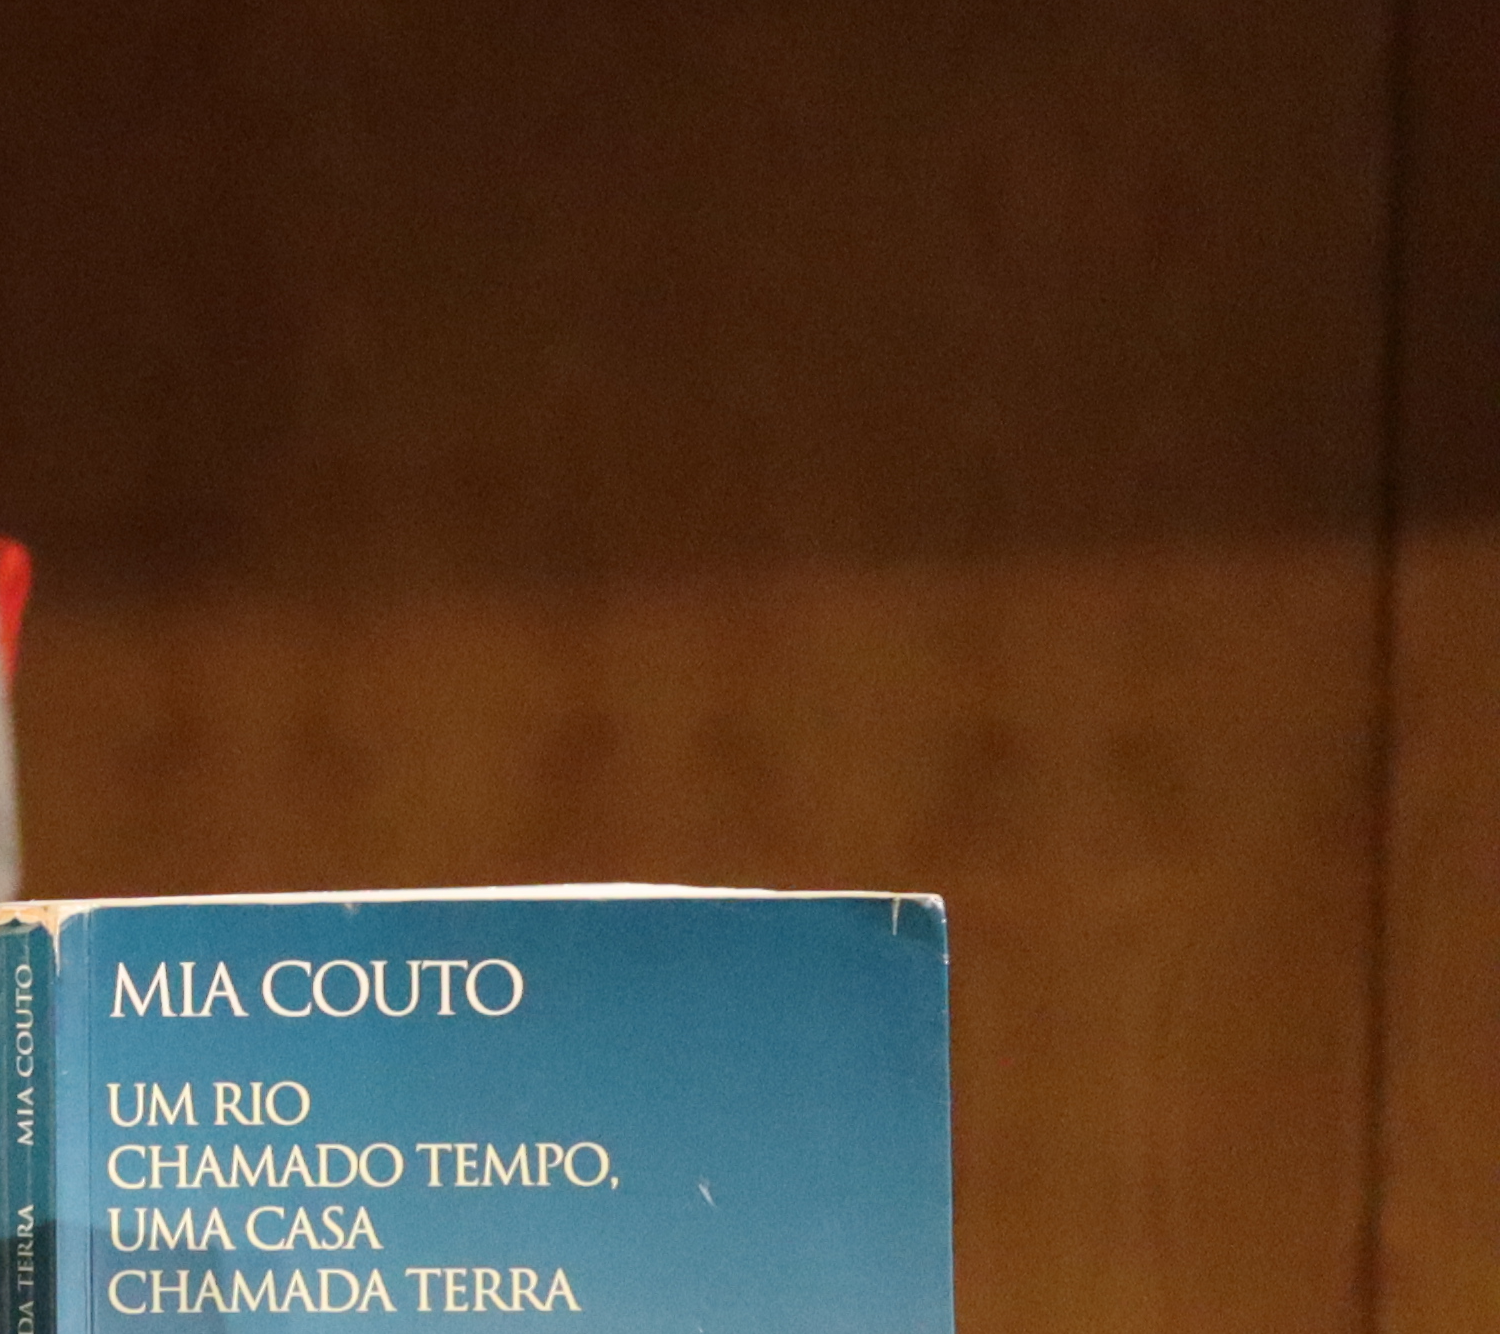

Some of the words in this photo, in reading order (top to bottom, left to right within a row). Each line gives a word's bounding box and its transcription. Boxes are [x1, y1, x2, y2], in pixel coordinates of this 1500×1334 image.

[108, 961, 250, 1019] MIA
[261, 959, 524, 1019] COUTO
[14, 963, 35, 1078] COUTO
[16, 1086, 35, 1147] MIA
[107, 1082, 198, 1127] UM
[213, 1081, 311, 1127] RIO
[106, 1143, 404, 1190] CHAMADO
[415, 1142, 620, 1191] TEMPO,
[16, 1204, 35, 1291] TERRA
[107, 1207, 236, 1252] UMA
[245, 1205, 384, 1251] CASA
[106, 1269, 397, 1316] CHAMADA
[405, 1267, 582, 1314] TERRA
